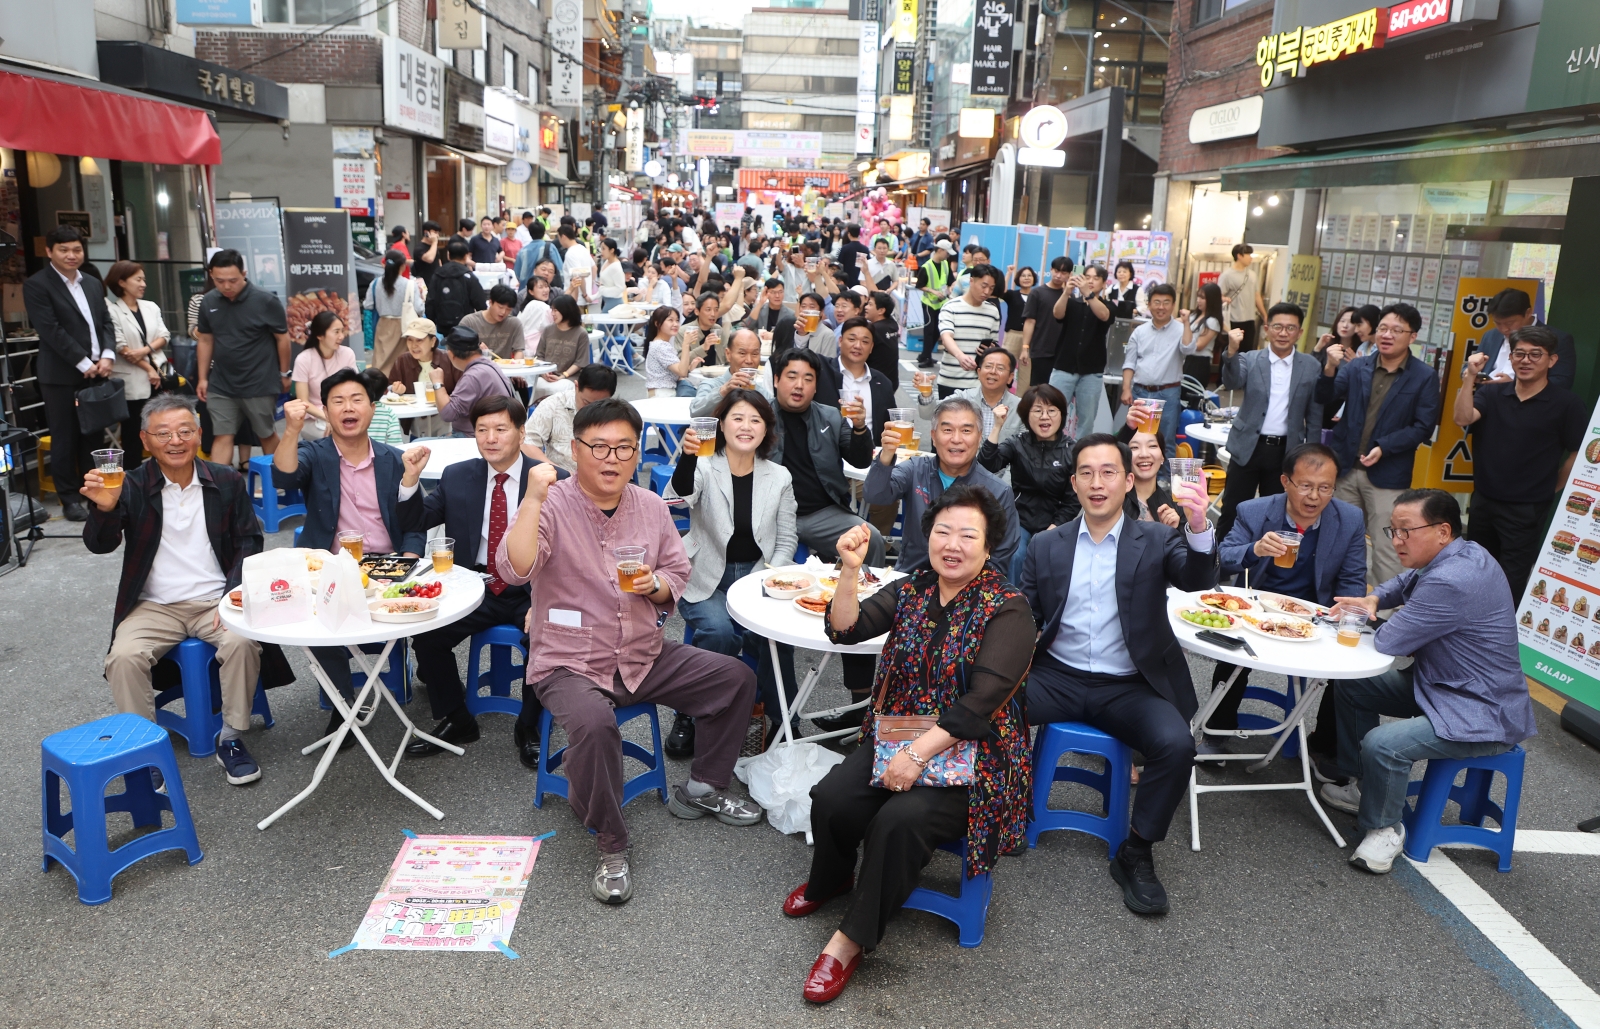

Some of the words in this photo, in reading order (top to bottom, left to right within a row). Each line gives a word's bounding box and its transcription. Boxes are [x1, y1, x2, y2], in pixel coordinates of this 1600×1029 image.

[1389, 1, 1448, 32] 541-8004
[983, 44, 1003, 54] HAIR
[1256, 26, 1303, 88] 행복
[1304, 15, 1375, 60] 공인중개사
[974, 59, 998, 69] MAKE
[998, 60, 1010, 69] UP
[399, 53, 441, 111] 대봉집
[897, 59, 912, 93] 양갈비
[1534, 661, 1575, 685] SALADY
[385, 901, 448, 921] FESTA
[448, 904, 501, 922] BEER
[367, 917, 501, 936] K-BEAUTY
